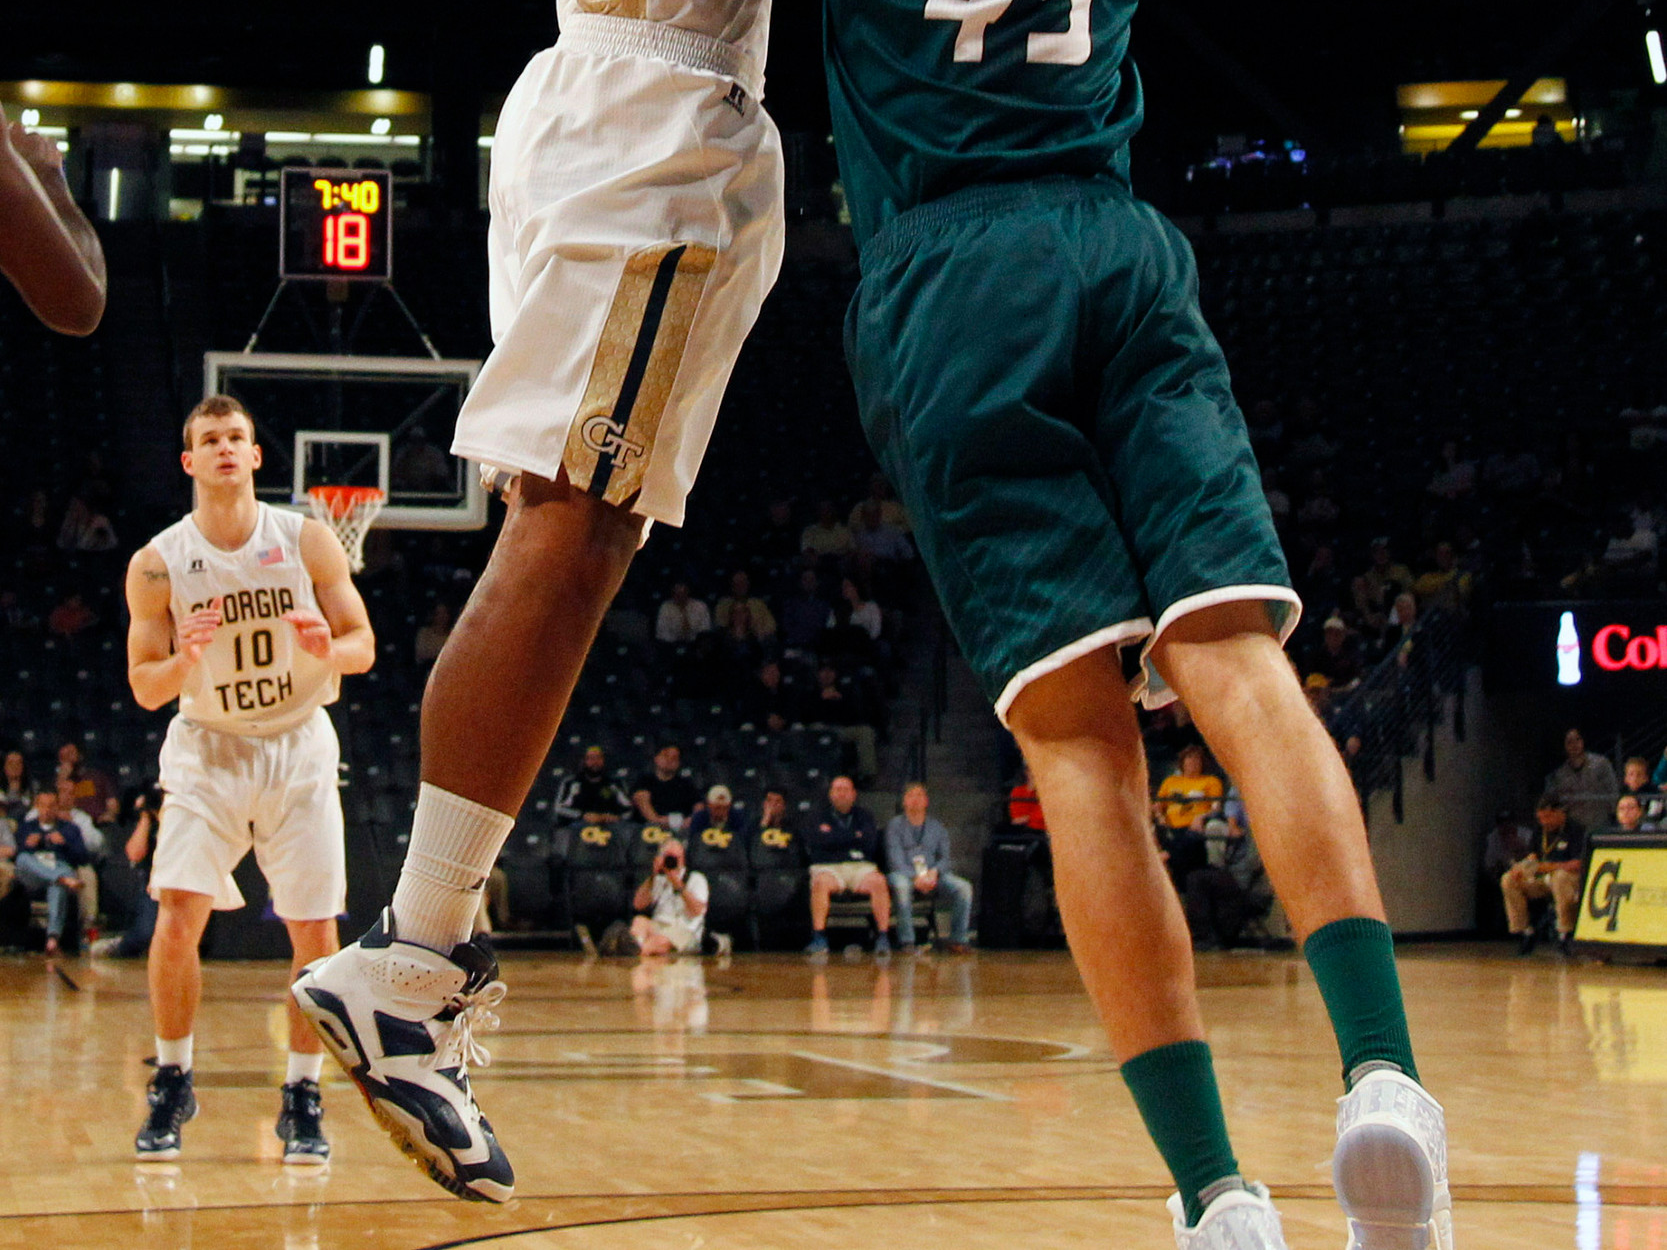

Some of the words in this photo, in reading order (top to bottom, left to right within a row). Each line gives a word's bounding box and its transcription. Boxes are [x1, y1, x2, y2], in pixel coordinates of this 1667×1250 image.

[313, 178, 380, 214] 7:40
[323, 213, 370, 270] 18
[581, 414, 645, 470] GT
[234, 628, 274, 672] 10
[214, 670, 293, 713] TECH
